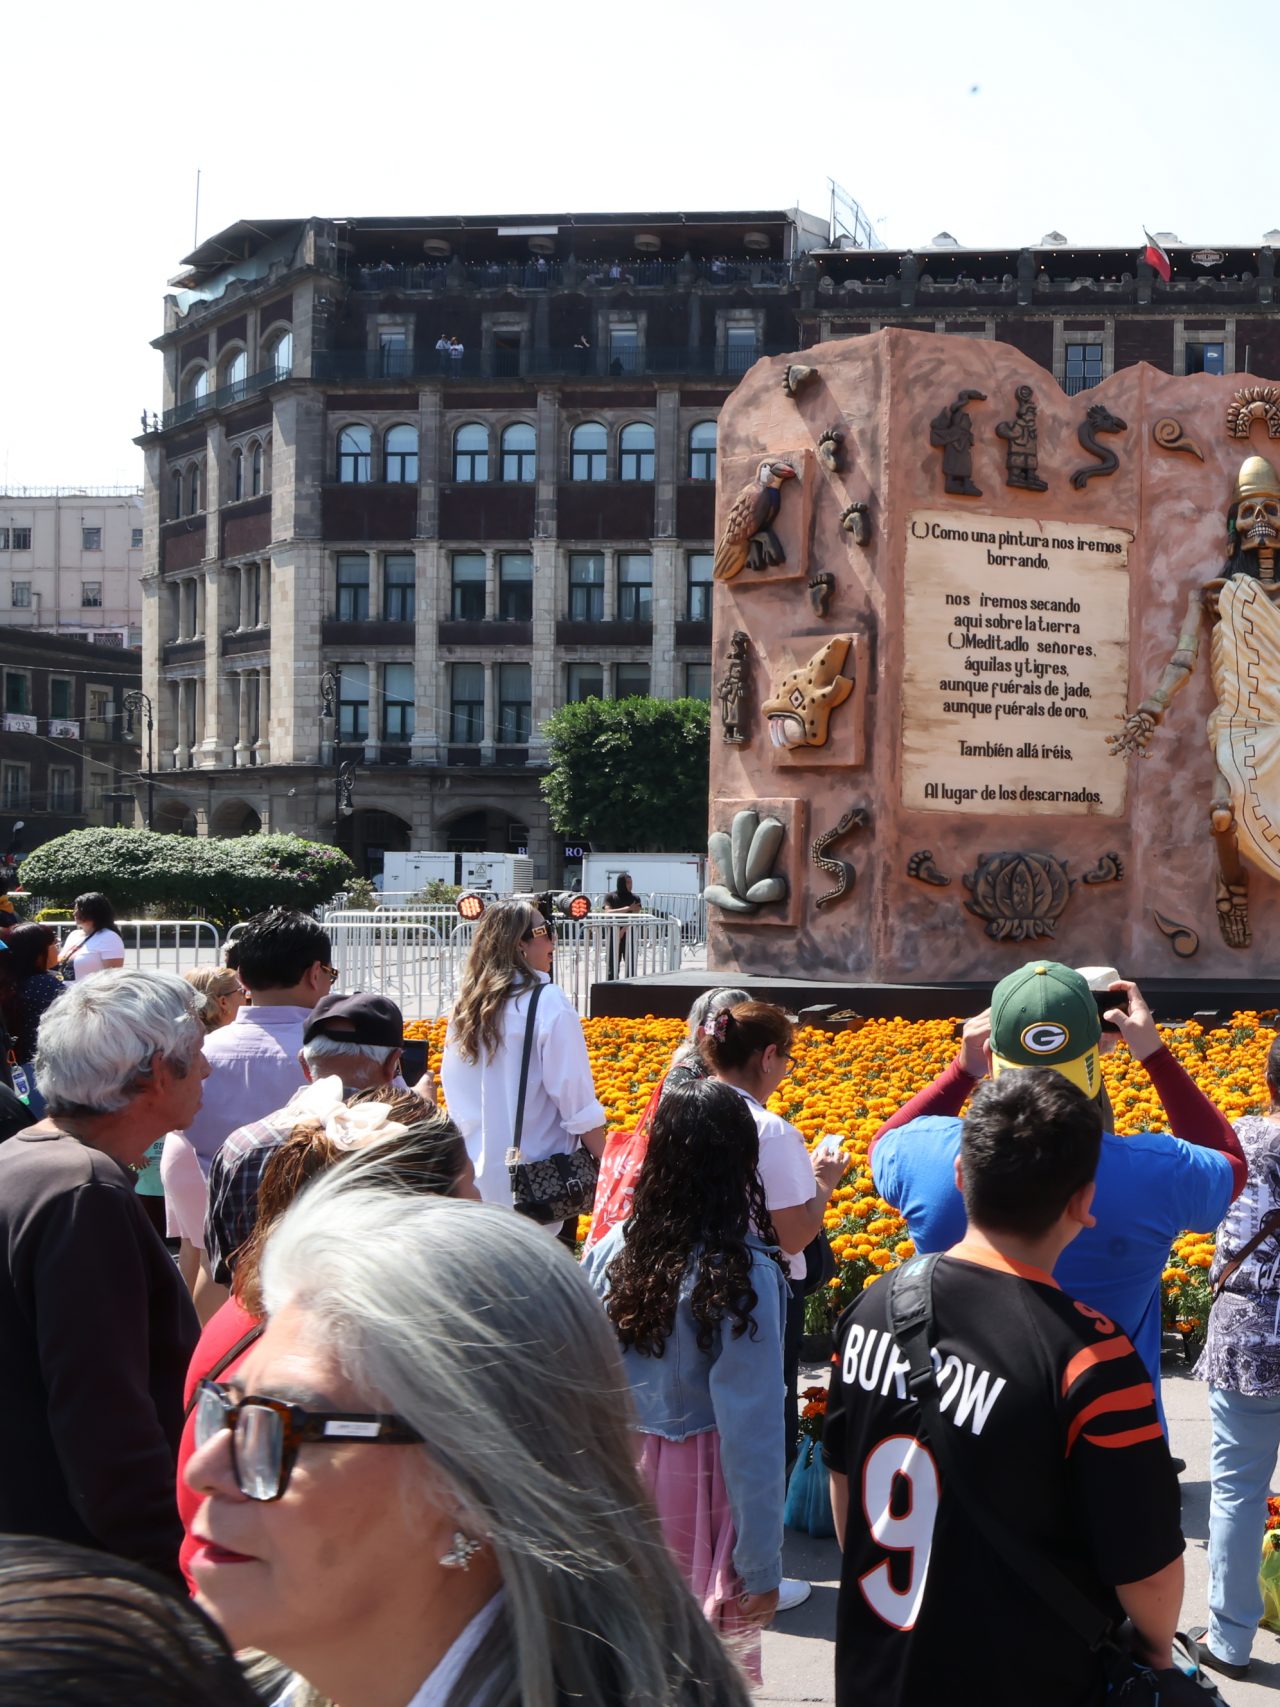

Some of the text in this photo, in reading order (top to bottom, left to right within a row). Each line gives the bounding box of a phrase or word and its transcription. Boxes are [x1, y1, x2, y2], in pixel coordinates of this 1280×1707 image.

[931, 523, 969, 542] Como
[971, 530, 996, 544] una
[998, 530, 1050, 550] pintura
[1052, 537, 1075, 550] nos
[1076, 536, 1123, 554] iremos
[987, 549, 1050, 570] borrando,
[945, 592, 1081, 613] nos iremos secando
[954, 613, 1080, 634] aqui sobre la tierra
[964, 656, 1069, 679] águilas y tigres,
[939, 679, 1092, 701] aunque fuérais de jade,
[943, 700, 1089, 720] aunque fuérais de oro,
[1016, 742, 1038, 759] allá
[924, 782, 1104, 805] Al lugar de los descarnados.
[1024, 1025, 1066, 1052] G
[842, 1324, 1007, 1436] BUROW
[858, 1433, 943, 1632] 9
